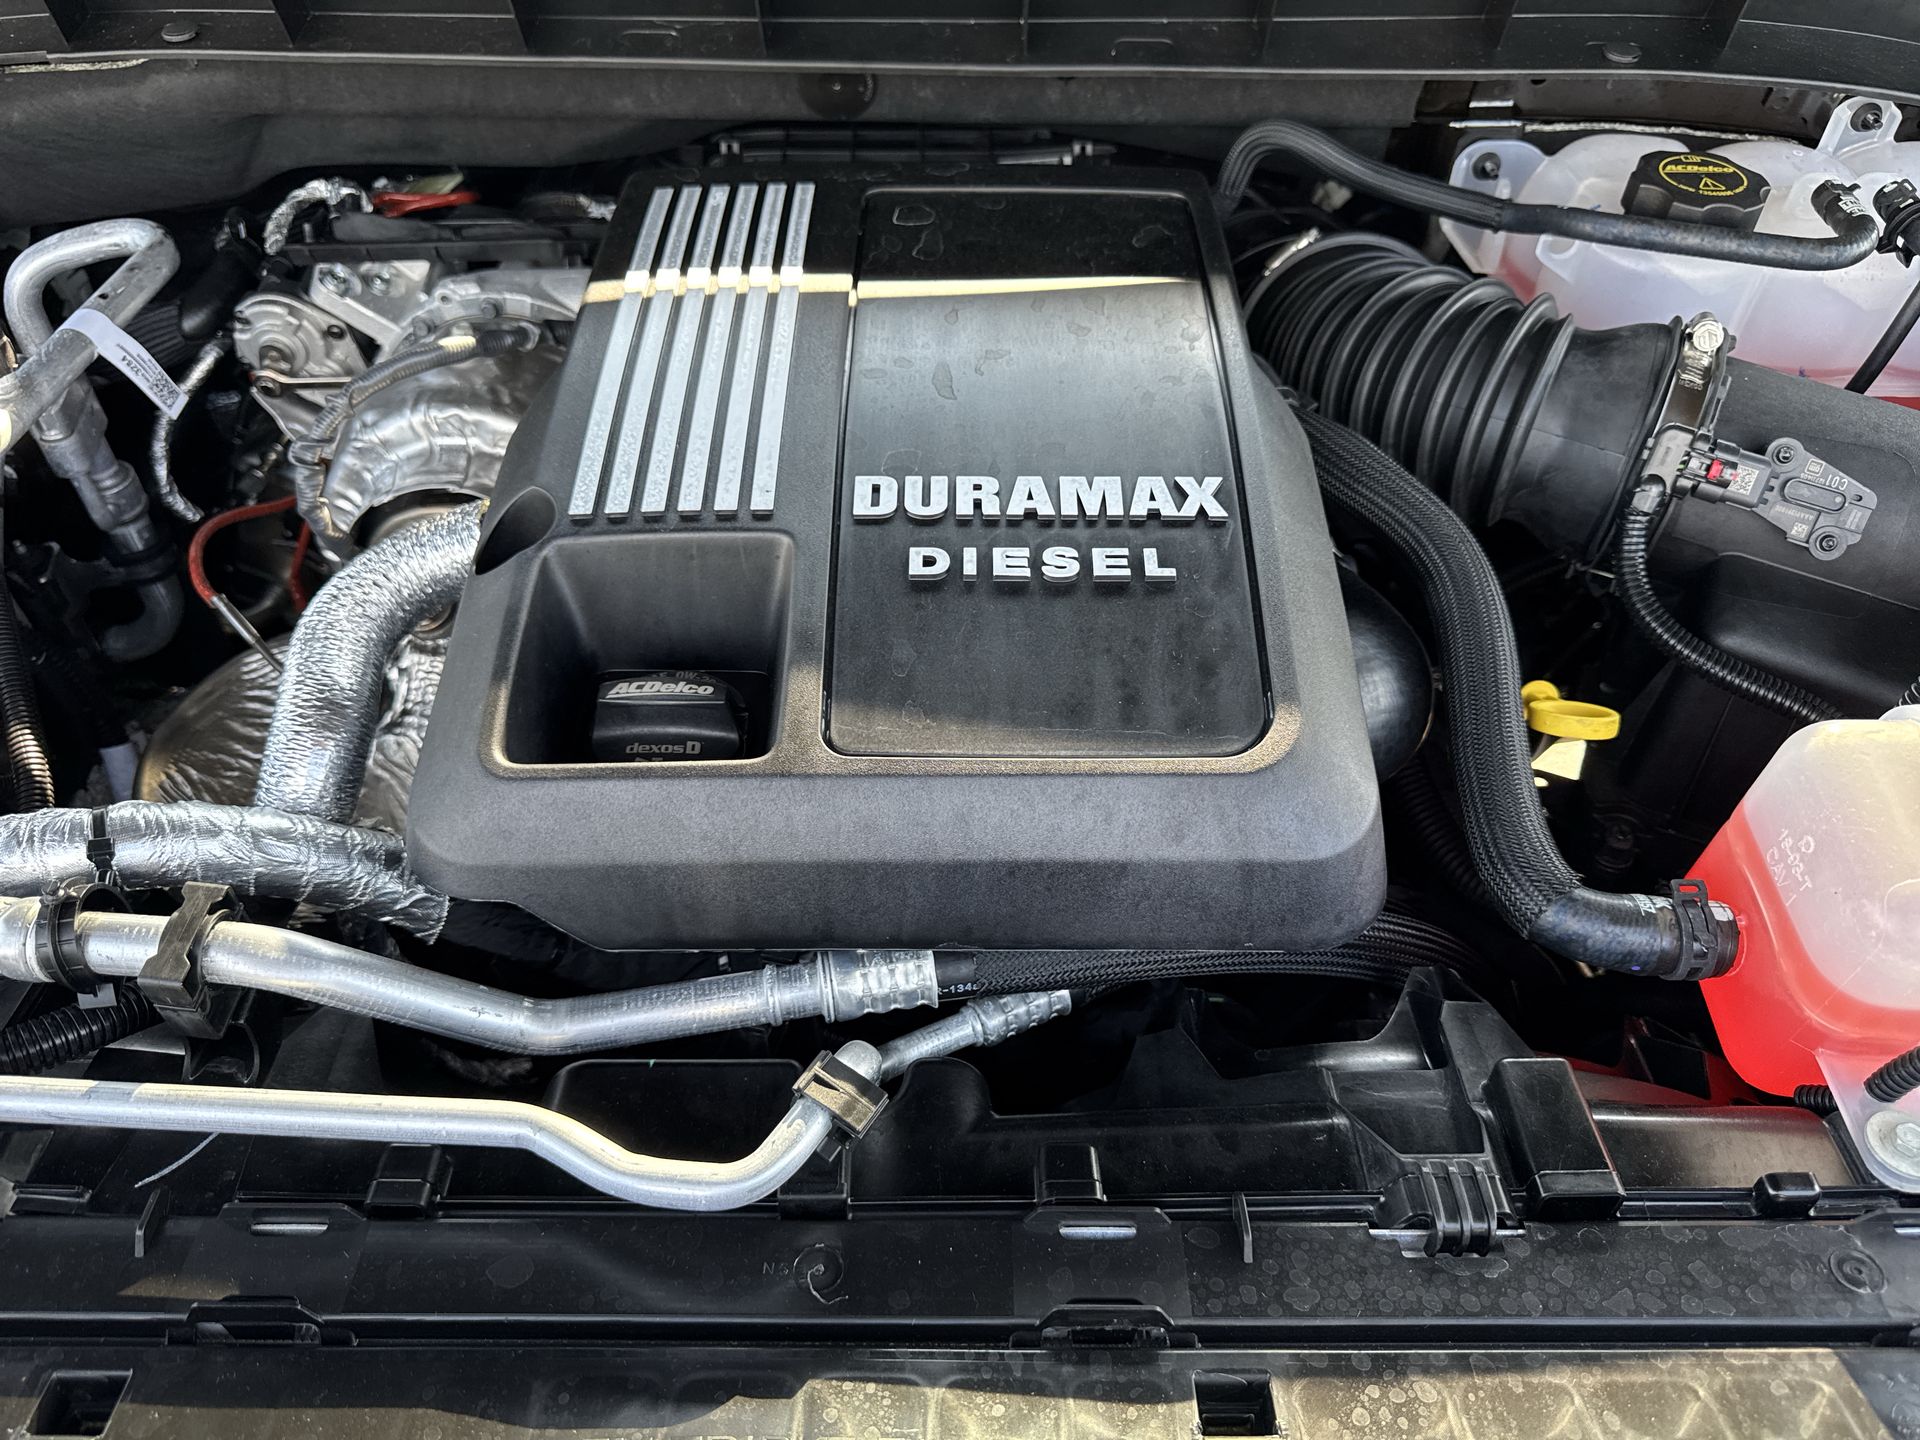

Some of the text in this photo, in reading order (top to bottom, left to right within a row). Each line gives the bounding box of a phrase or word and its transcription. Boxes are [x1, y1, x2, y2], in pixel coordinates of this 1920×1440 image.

[1663, 164, 1734, 173] ACDelco
[853, 475, 1229, 521] DURAMAX
[908, 546, 1177, 582] DIESEL
[607, 681, 715, 697] ACDelco
